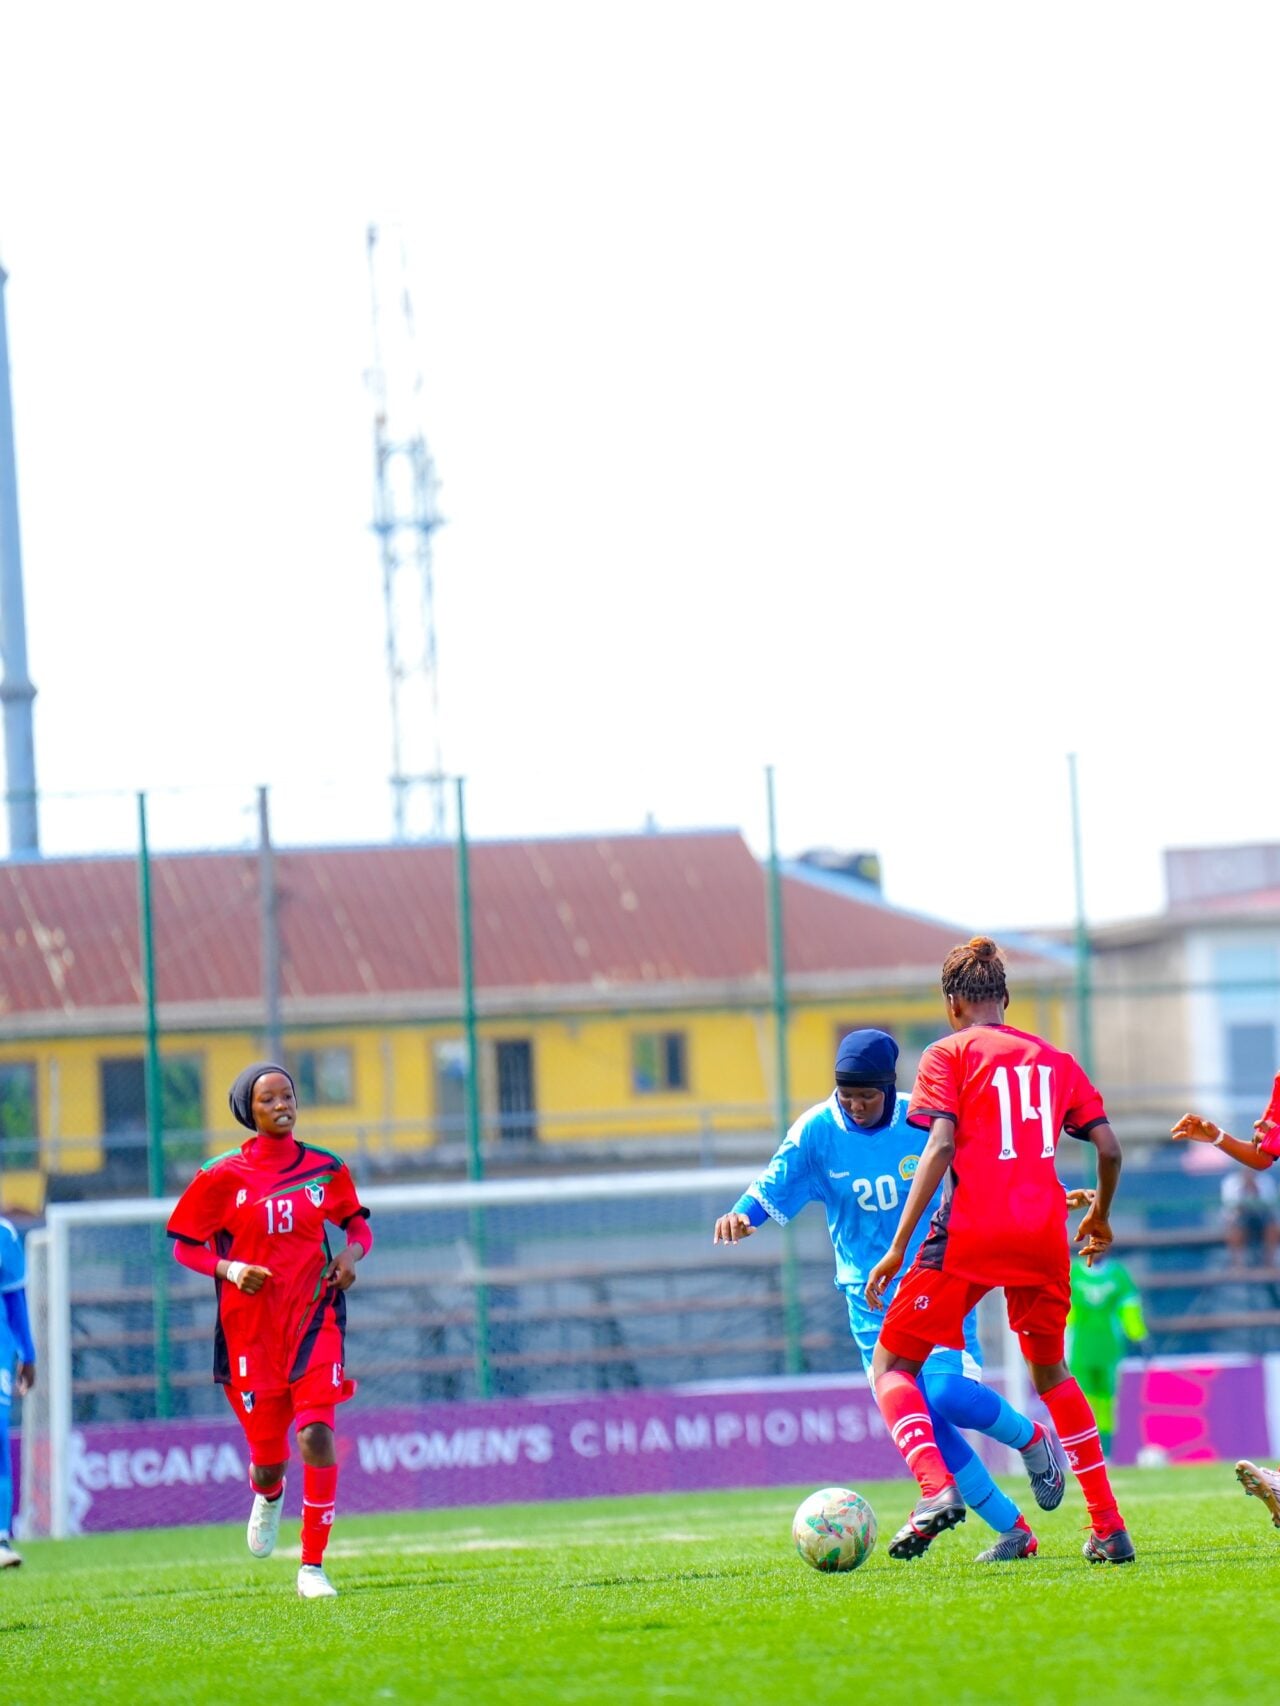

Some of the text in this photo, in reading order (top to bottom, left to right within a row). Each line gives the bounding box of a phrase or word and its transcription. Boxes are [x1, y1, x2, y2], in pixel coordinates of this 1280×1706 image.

[991, 1064, 1055, 1160] 14
[852, 1174, 899, 1212] 20
[265, 1199, 293, 1234] 13
[78, 1444, 246, 1490] CECAFA
[356, 1423, 553, 1474] WOMEN'S
[898, 1427, 925, 1450] SFA
